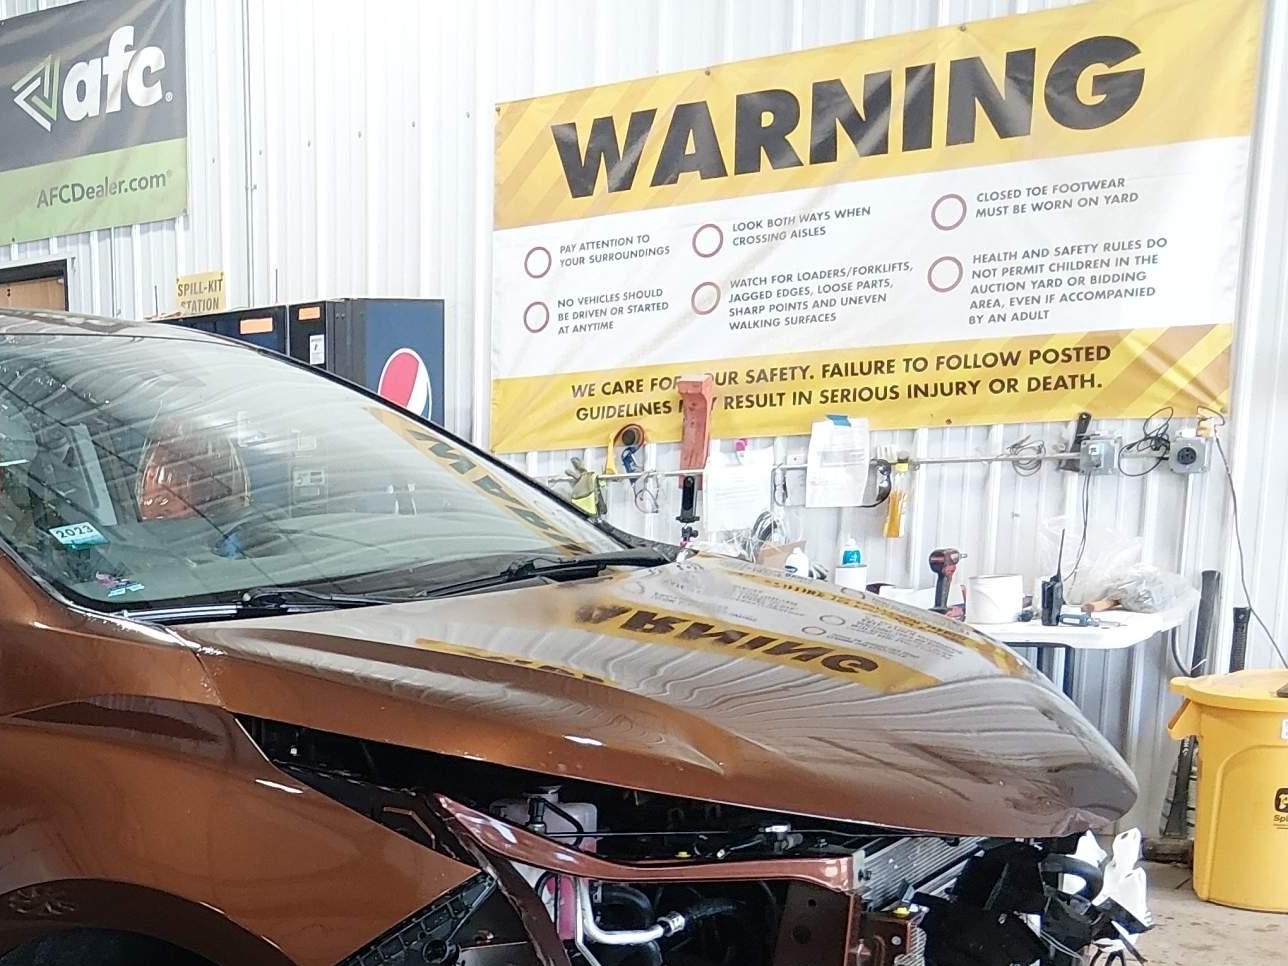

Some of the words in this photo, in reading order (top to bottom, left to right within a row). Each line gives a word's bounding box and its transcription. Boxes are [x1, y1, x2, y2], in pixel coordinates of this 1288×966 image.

[551, 36, 1146, 199] WARNING
[976, 189, 1021, 202] CLOSED
[1026, 186, 1048, 197] TOE
[1052, 178, 1125, 194] FOOTWEAR
[975, 205, 1009, 218] MUST
[1013, 203, 1027, 214] BE
[1031, 199, 1073, 212] WORN
[1077, 197, 1099, 208] ON
[1104, 192, 1139, 205] YARD
[732, 220, 763, 232] LOOK
[767, 216, 795, 227] BOTH
[799, 211, 831, 223] WAYS
[834, 206, 871, 219] WHEN
[560, 243, 577, 254] PAY
[579, 236, 633, 251] ATTENTION
[637, 234, 650, 244] TO
[732, 231, 787, 246] CROSSING
[790, 226, 826, 239] AISLES
[560, 256, 585, 267] YOUR
[589, 245, 670, 264] SURROUNDINGS
[972, 252, 1018, 264] HEALTH
[1021, 248, 1050, 260] AND
[1054, 243, 1098, 257] SAFETY
[1103, 240, 1142, 252] RULES
[1146, 237, 1168, 249] DO
[730, 276, 767, 288] WATCH
[771, 273, 793, 284] FOR
[797, 261, 914, 281] LOADERS/FORKLIFTS,
[972, 268, 998, 280] NOT
[1002, 264, 1045, 277] PERMIT
[1048, 258, 1111, 273] CHILDREN
[1115, 257, 1130, 267] IN
[1134, 254, 1159, 265] THE
[177, 279, 223, 297] SPILL-KIT
[729, 290, 773, 303] JAGGED
[776, 287, 813, 298] EDGES,
[817, 282, 853, 294] LOOSE
[856, 278, 894, 290] PARTS,
[970, 281, 1026, 295] AUCTION
[1031, 278, 1062, 289] YARD
[1067, 276, 1086, 286] OR
[1090, 271, 1147, 285] BIDDING
[558, 299, 574, 308] NO
[578, 293, 620, 305] VEHICLES
[623, 288, 663, 301] SHOULD
[729, 305, 765, 317] SHARP
[769, 301, 809, 313] POINTS
[812, 298, 837, 309] AND
[840, 293, 887, 306] UNEVEN
[969, 298, 1005, 310] AREA,
[1009, 295, 1041, 307] EVEN
[1045, 293, 1055, 304] IF
[1059, 287, 1156, 303] ACCOMPANIED
[558, 313, 569, 321] BE
[572, 308, 607, 320] DRIVEN
[610, 306, 624, 316] OR
[627, 302, 669, 314] STARTED
[729, 318, 781, 330] WALKING
[784, 313, 837, 326] SURFACES
[969, 315, 984, 325] BY
[988, 313, 1007, 323] AN
[1010, 310, 1050, 322] ADULT
[558, 326, 569, 335] AT
[572, 321, 614, 333] ANYTIME
[572, 384, 596, 398] WE
[601, 379, 644, 395] CARE
[746, 365, 814, 384] SAFETY.
[821, 359, 896, 379] FAILURE
[903, 357, 928, 373] TO
[935, 350, 1022, 370] FOLLOW
[1029, 345, 1111, 365] POSTED
[576, 400, 672, 422] GUIDELINES
[724, 391, 786, 410] RESULT
[792, 390, 812, 405] IN
[819, 385, 900, 405] SERIOUS
[907, 380, 982, 398] INJURY
[989, 378, 1019, 394] OR
[1027, 374, 1102, 392] DEATH.
[55, 524, 94, 539] 2023
